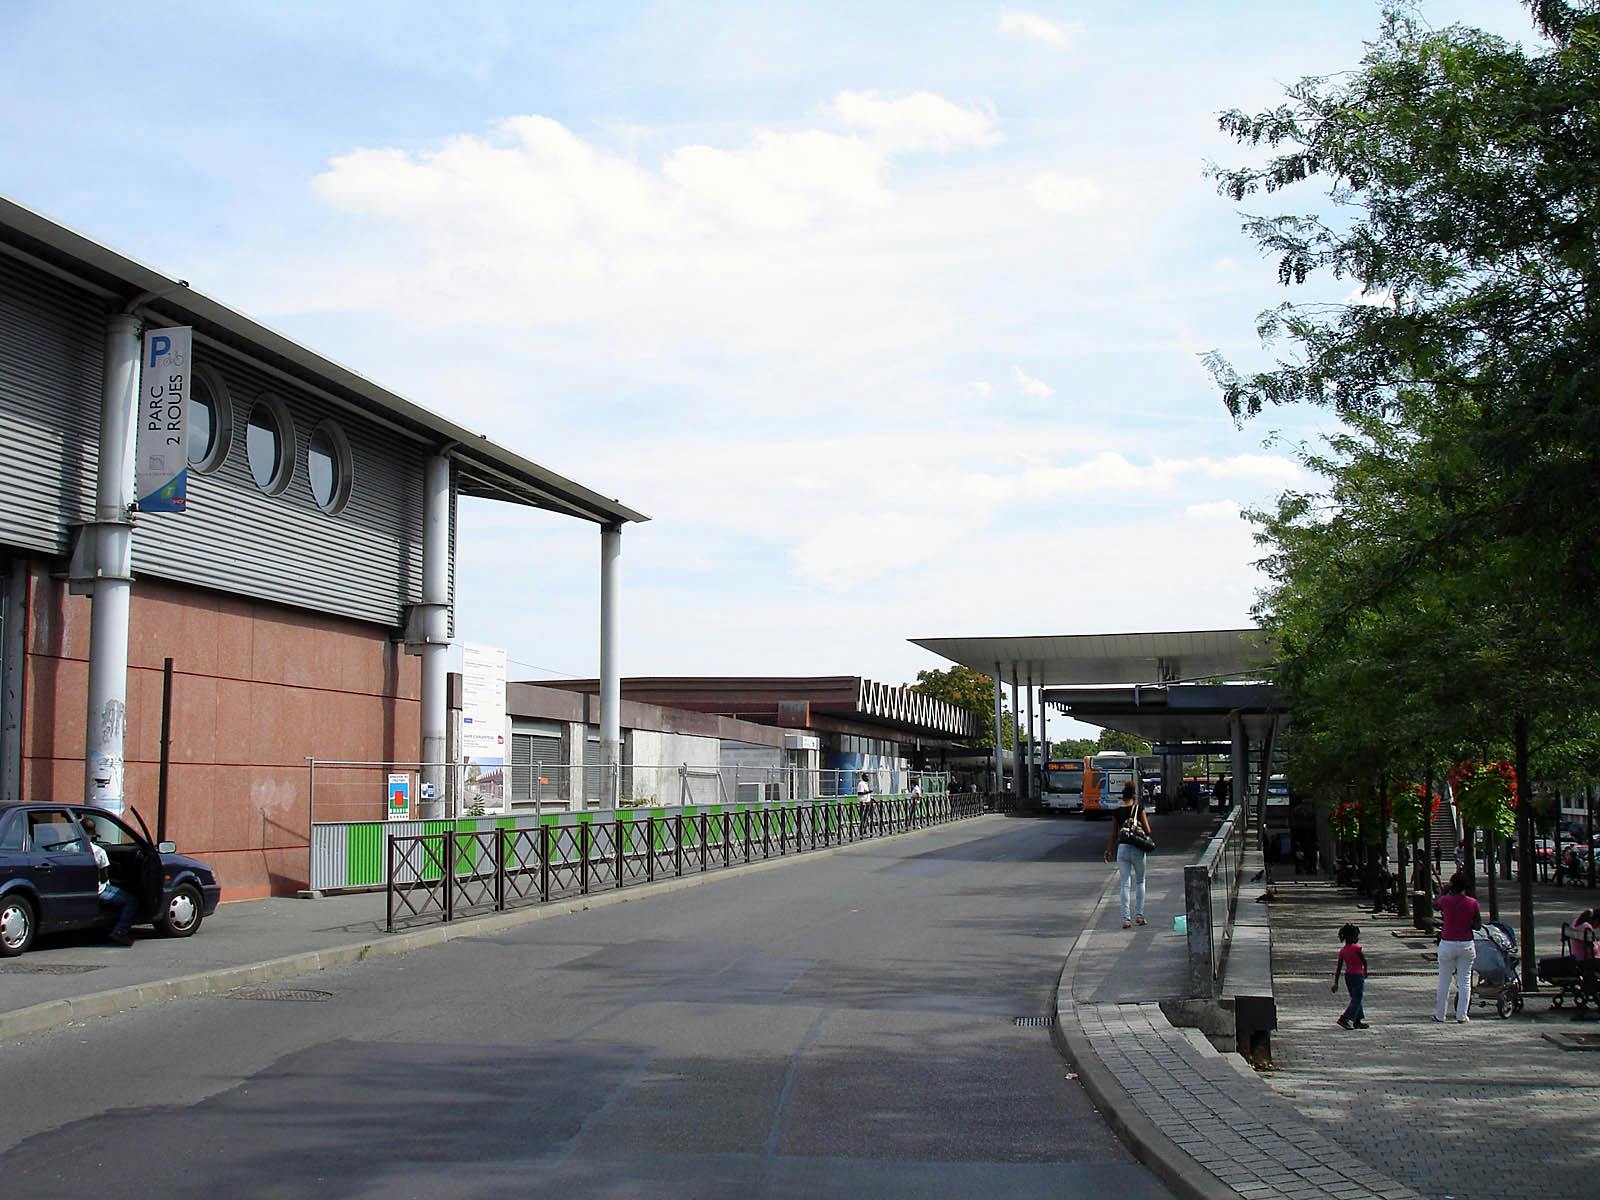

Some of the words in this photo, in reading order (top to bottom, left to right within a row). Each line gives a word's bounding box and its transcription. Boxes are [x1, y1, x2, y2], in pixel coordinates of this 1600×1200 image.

[150, 336, 171, 368] P
[148, 386, 163, 431] PARC
[168, 375, 183, 430] ROUES
[167, 436, 180, 445] 2
